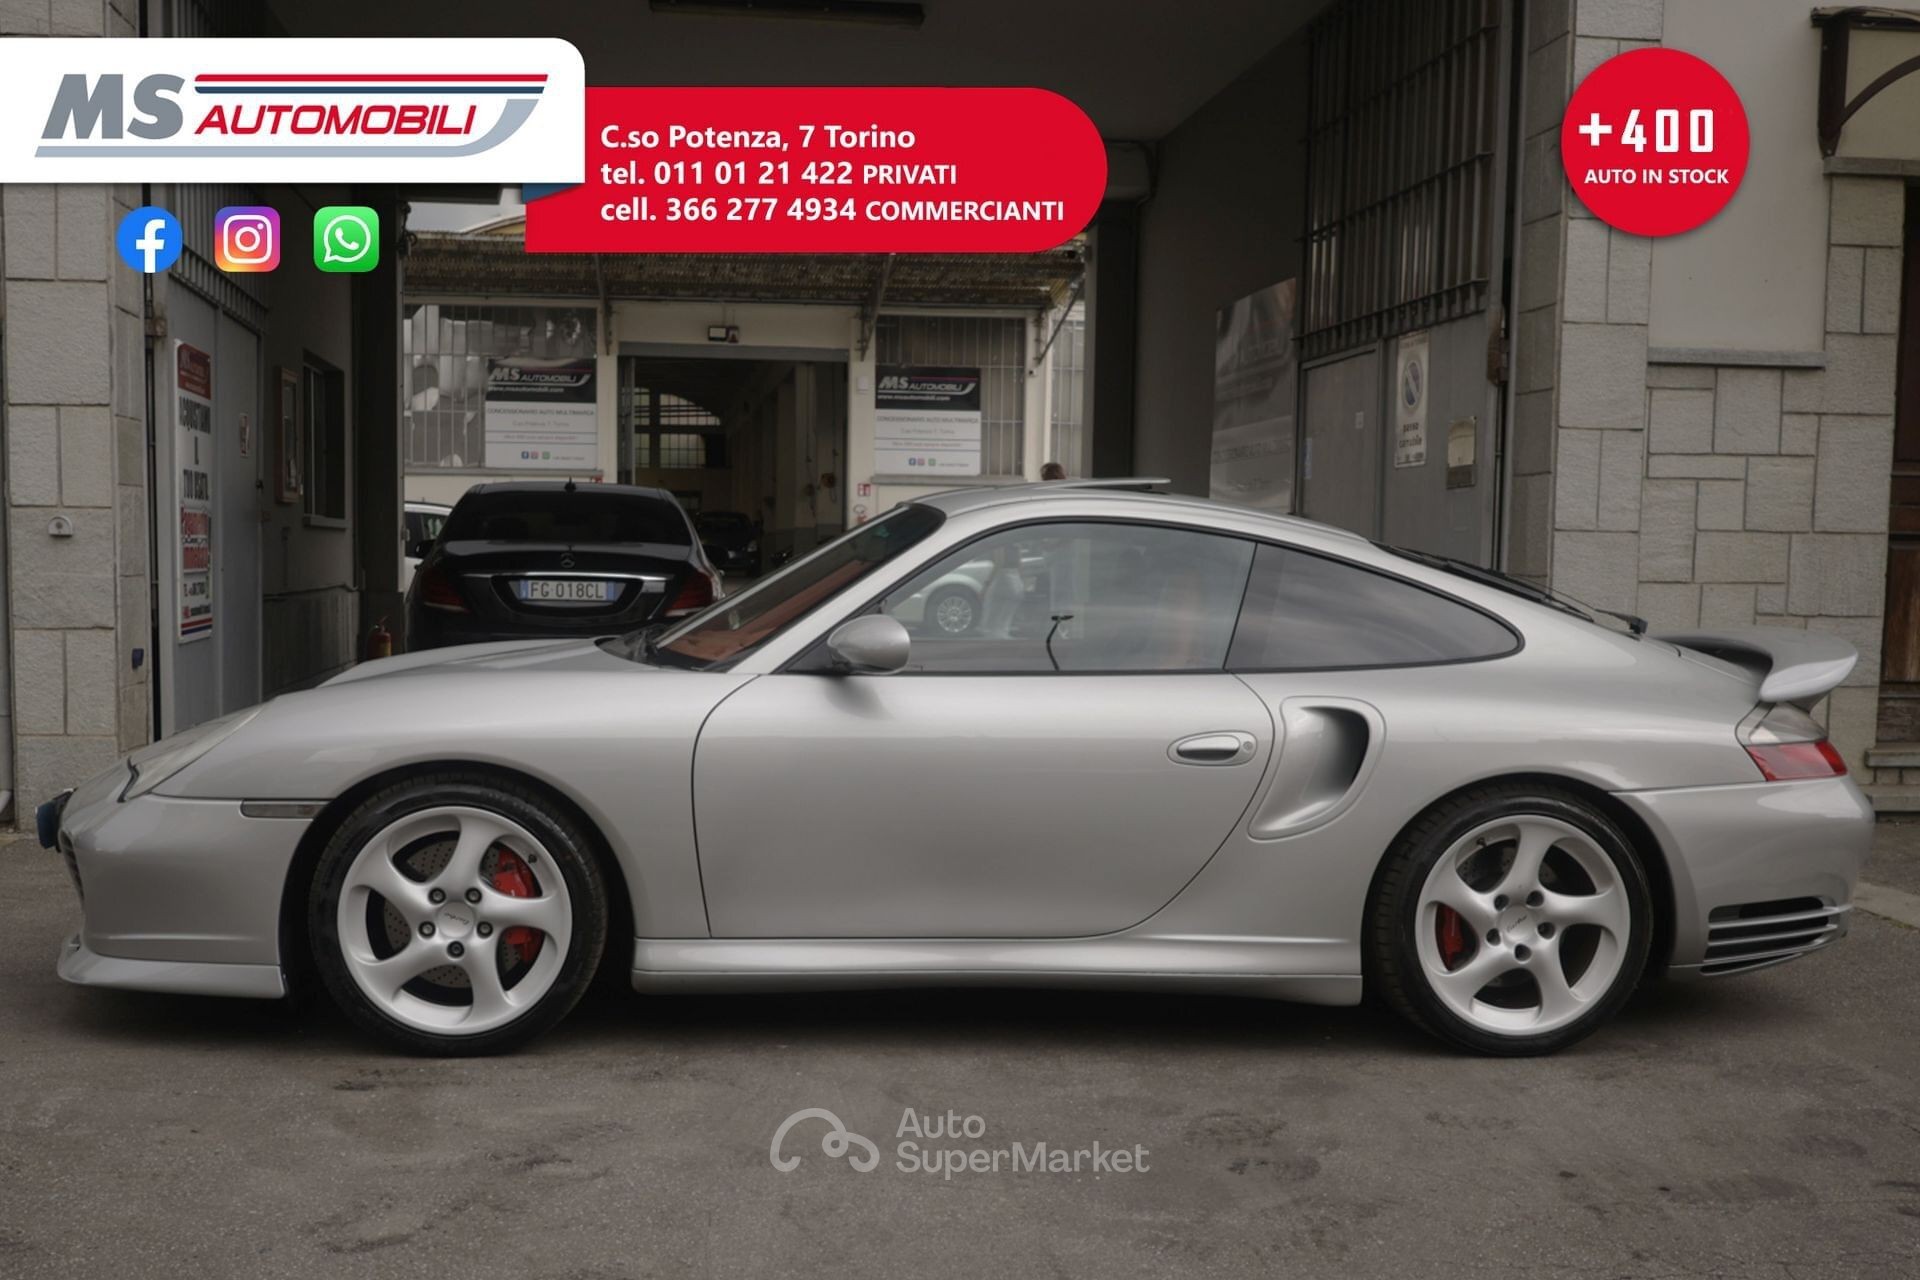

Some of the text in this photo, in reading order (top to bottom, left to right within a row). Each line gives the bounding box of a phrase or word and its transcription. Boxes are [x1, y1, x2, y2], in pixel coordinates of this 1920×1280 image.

[488, 367, 577, 383] MS AUTOMOBILI
[878, 376, 962, 391] MS AUTOMOBILI
[530, 582, 604, 599] FG 018CL
